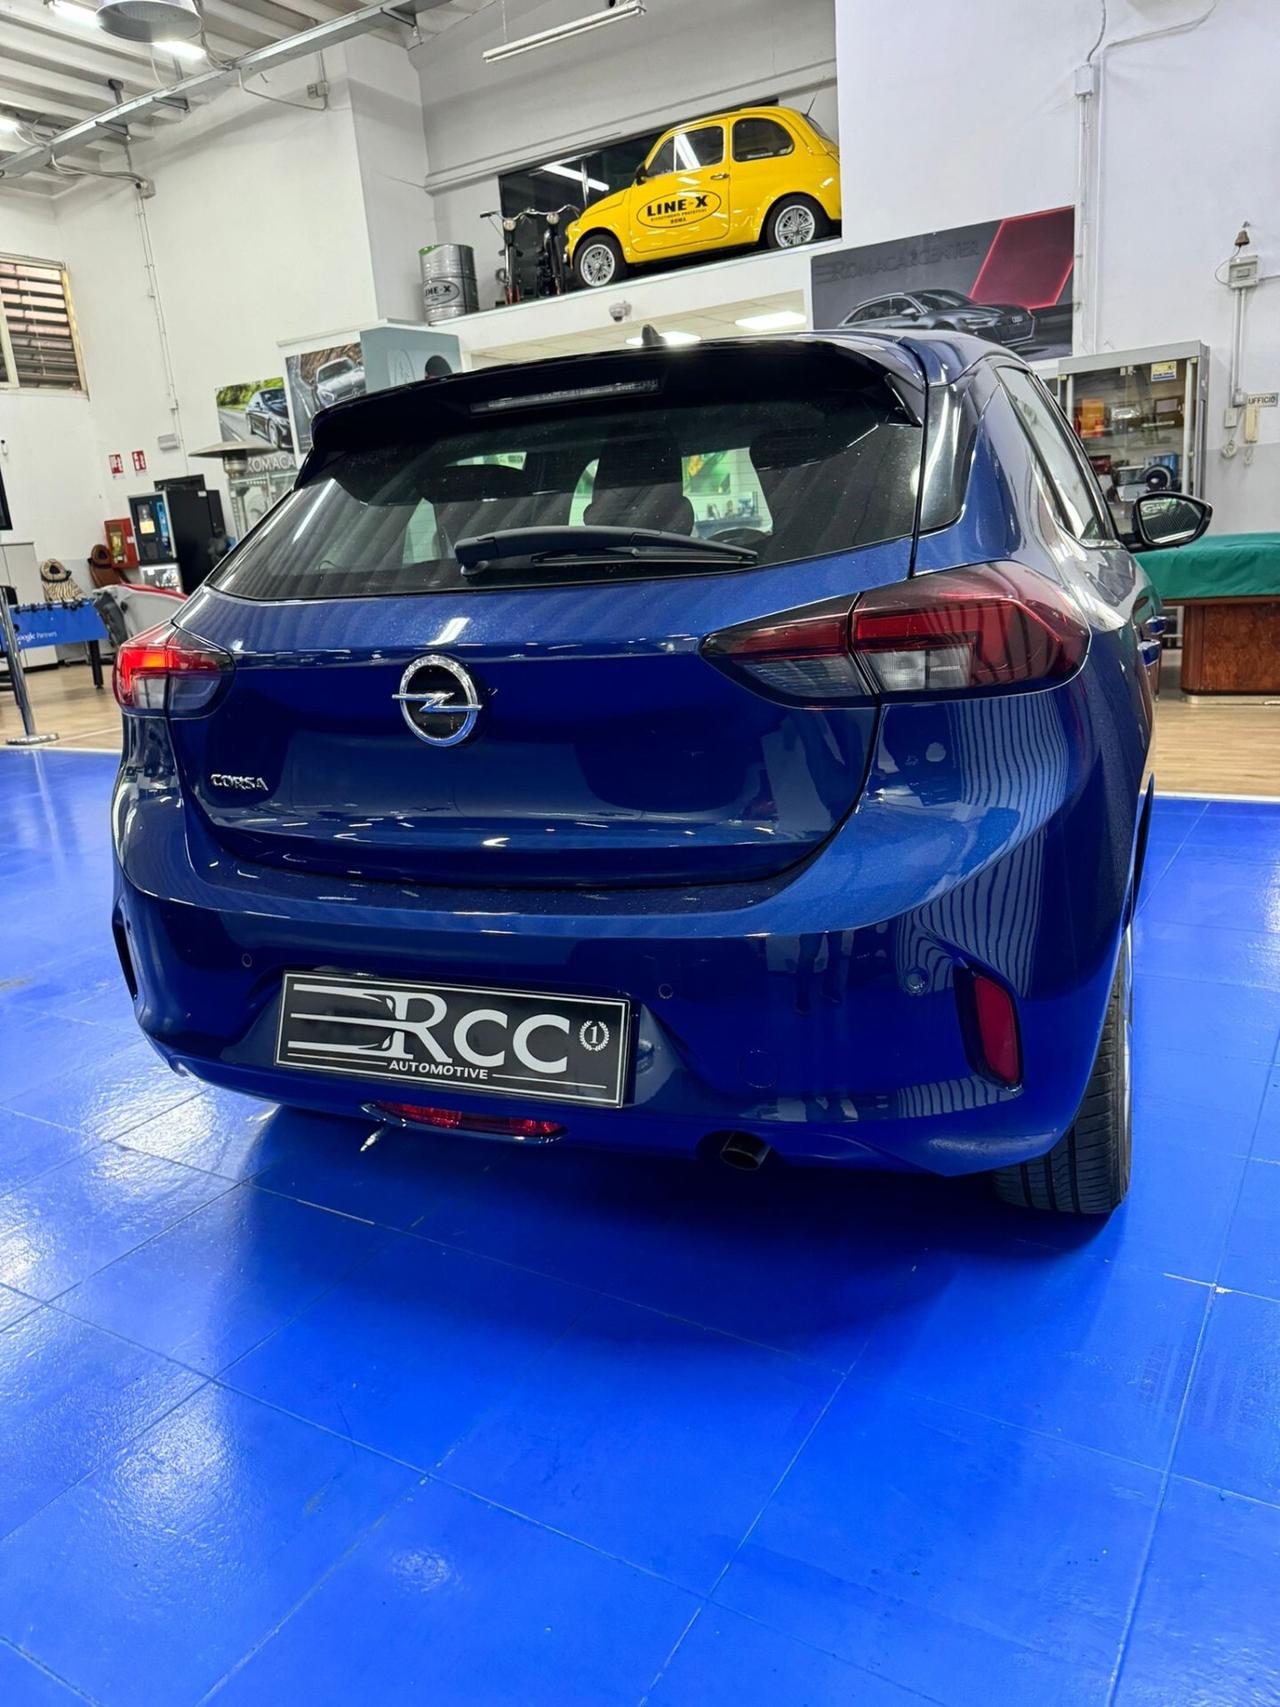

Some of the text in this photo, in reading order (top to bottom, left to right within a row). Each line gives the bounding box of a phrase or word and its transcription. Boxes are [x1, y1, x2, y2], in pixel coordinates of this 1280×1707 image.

[1248, 395, 1276, 405] UFFICIO
[16, 631, 36, 643] oogle
[210, 773, 269, 791] CORSA
[389, 1059, 488, 1080] AUTOMOTIVE
